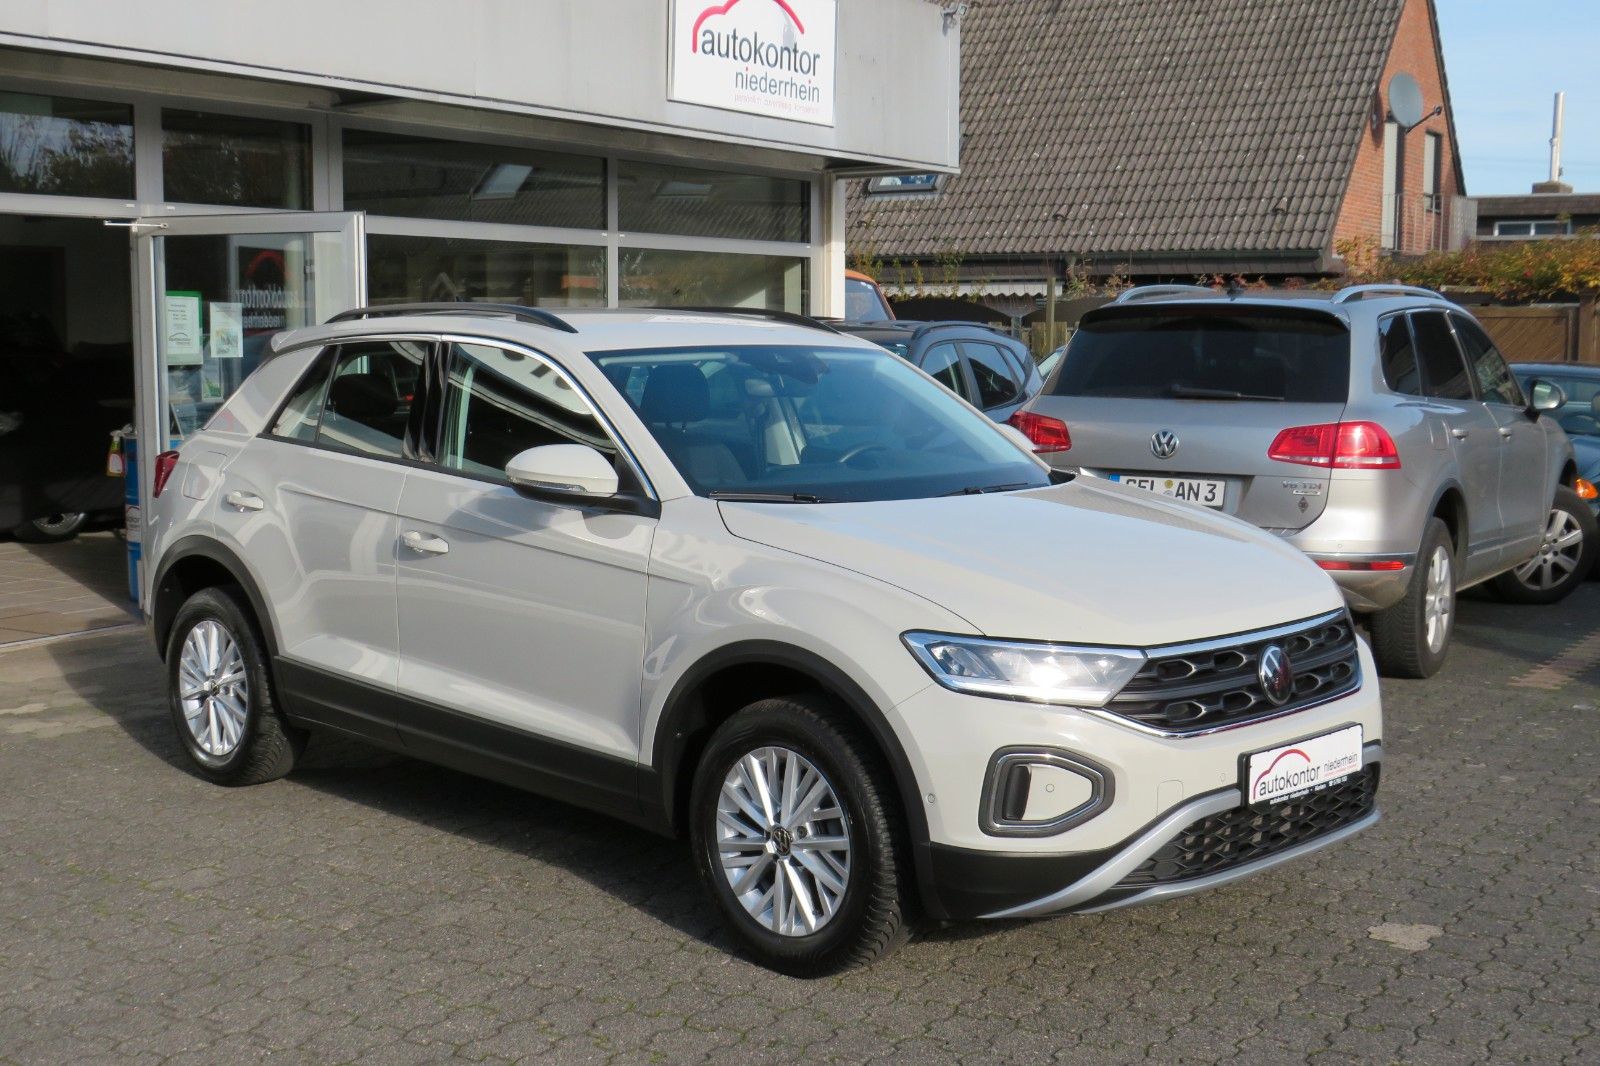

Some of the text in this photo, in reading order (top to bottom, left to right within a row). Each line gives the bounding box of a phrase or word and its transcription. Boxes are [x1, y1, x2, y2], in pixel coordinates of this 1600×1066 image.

[701, 27, 820, 77] autokontor
[735, 67, 820, 103] niederrhein
[1175, 481, 1201, 502] AN
[1204, 483, 1217, 503] 3
[1259, 765, 1321, 796] autokontor
[1323, 752, 1358, 772] niederrhein
